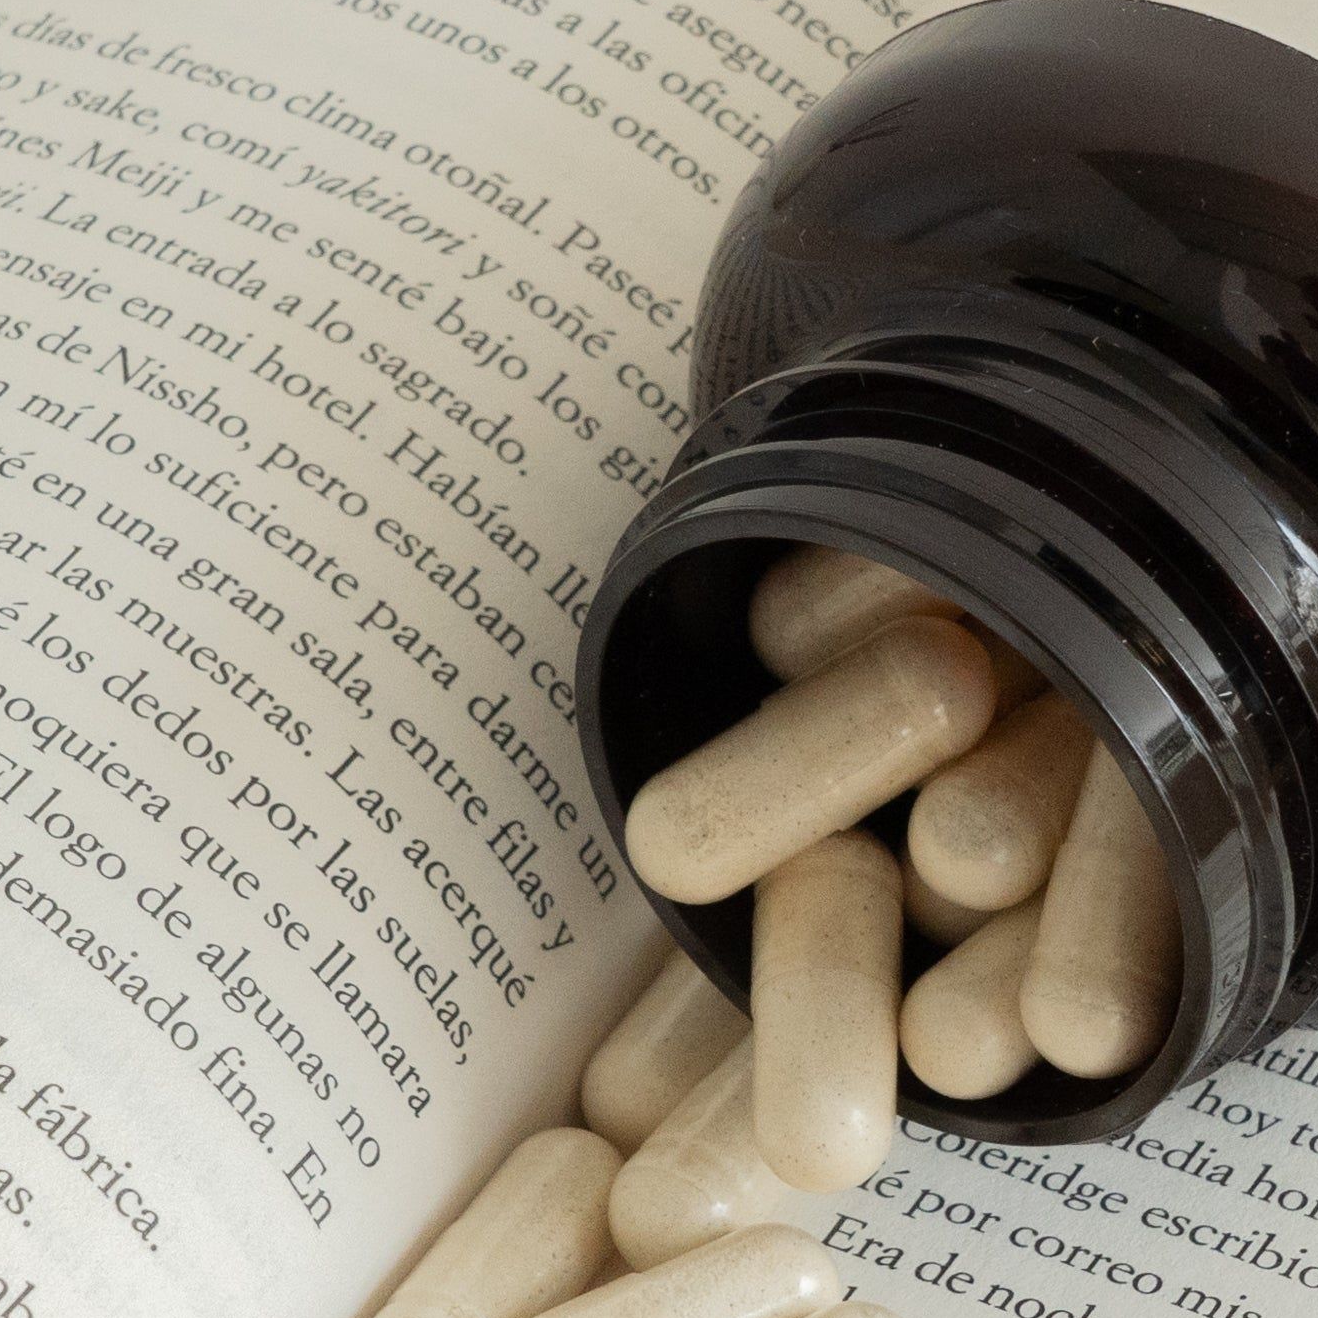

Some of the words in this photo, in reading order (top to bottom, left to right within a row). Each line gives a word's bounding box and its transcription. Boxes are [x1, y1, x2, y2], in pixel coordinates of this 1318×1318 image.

[150, 43, 279, 103] fresco
[282, 89, 399, 153] clima
[402, 143, 552, 237] otoñal.
[552, 219, 683, 329] Paseé
[403, 10, 509, 65] unos
[508, 58, 540, 82] a
[539, 62, 608, 120] los
[609, 114, 720, 206] otros.
[119, 296, 175, 331] en
[180, 321, 255, 363] mi
[249, 342, 379, 442] hotel.
[34, 323, 94, 365] de
[93, 343, 252, 453] Nissho,
[255, 441, 370, 519] pero
[373, 516, 527, 660] estaban
[23, 786, 128, 882] logo
[135, 881, 194, 940] de
[195, 942, 340, 1103] algunas
[334, 1104, 382, 1170] no
[16, 1082, 161, 1254] fábrica.
